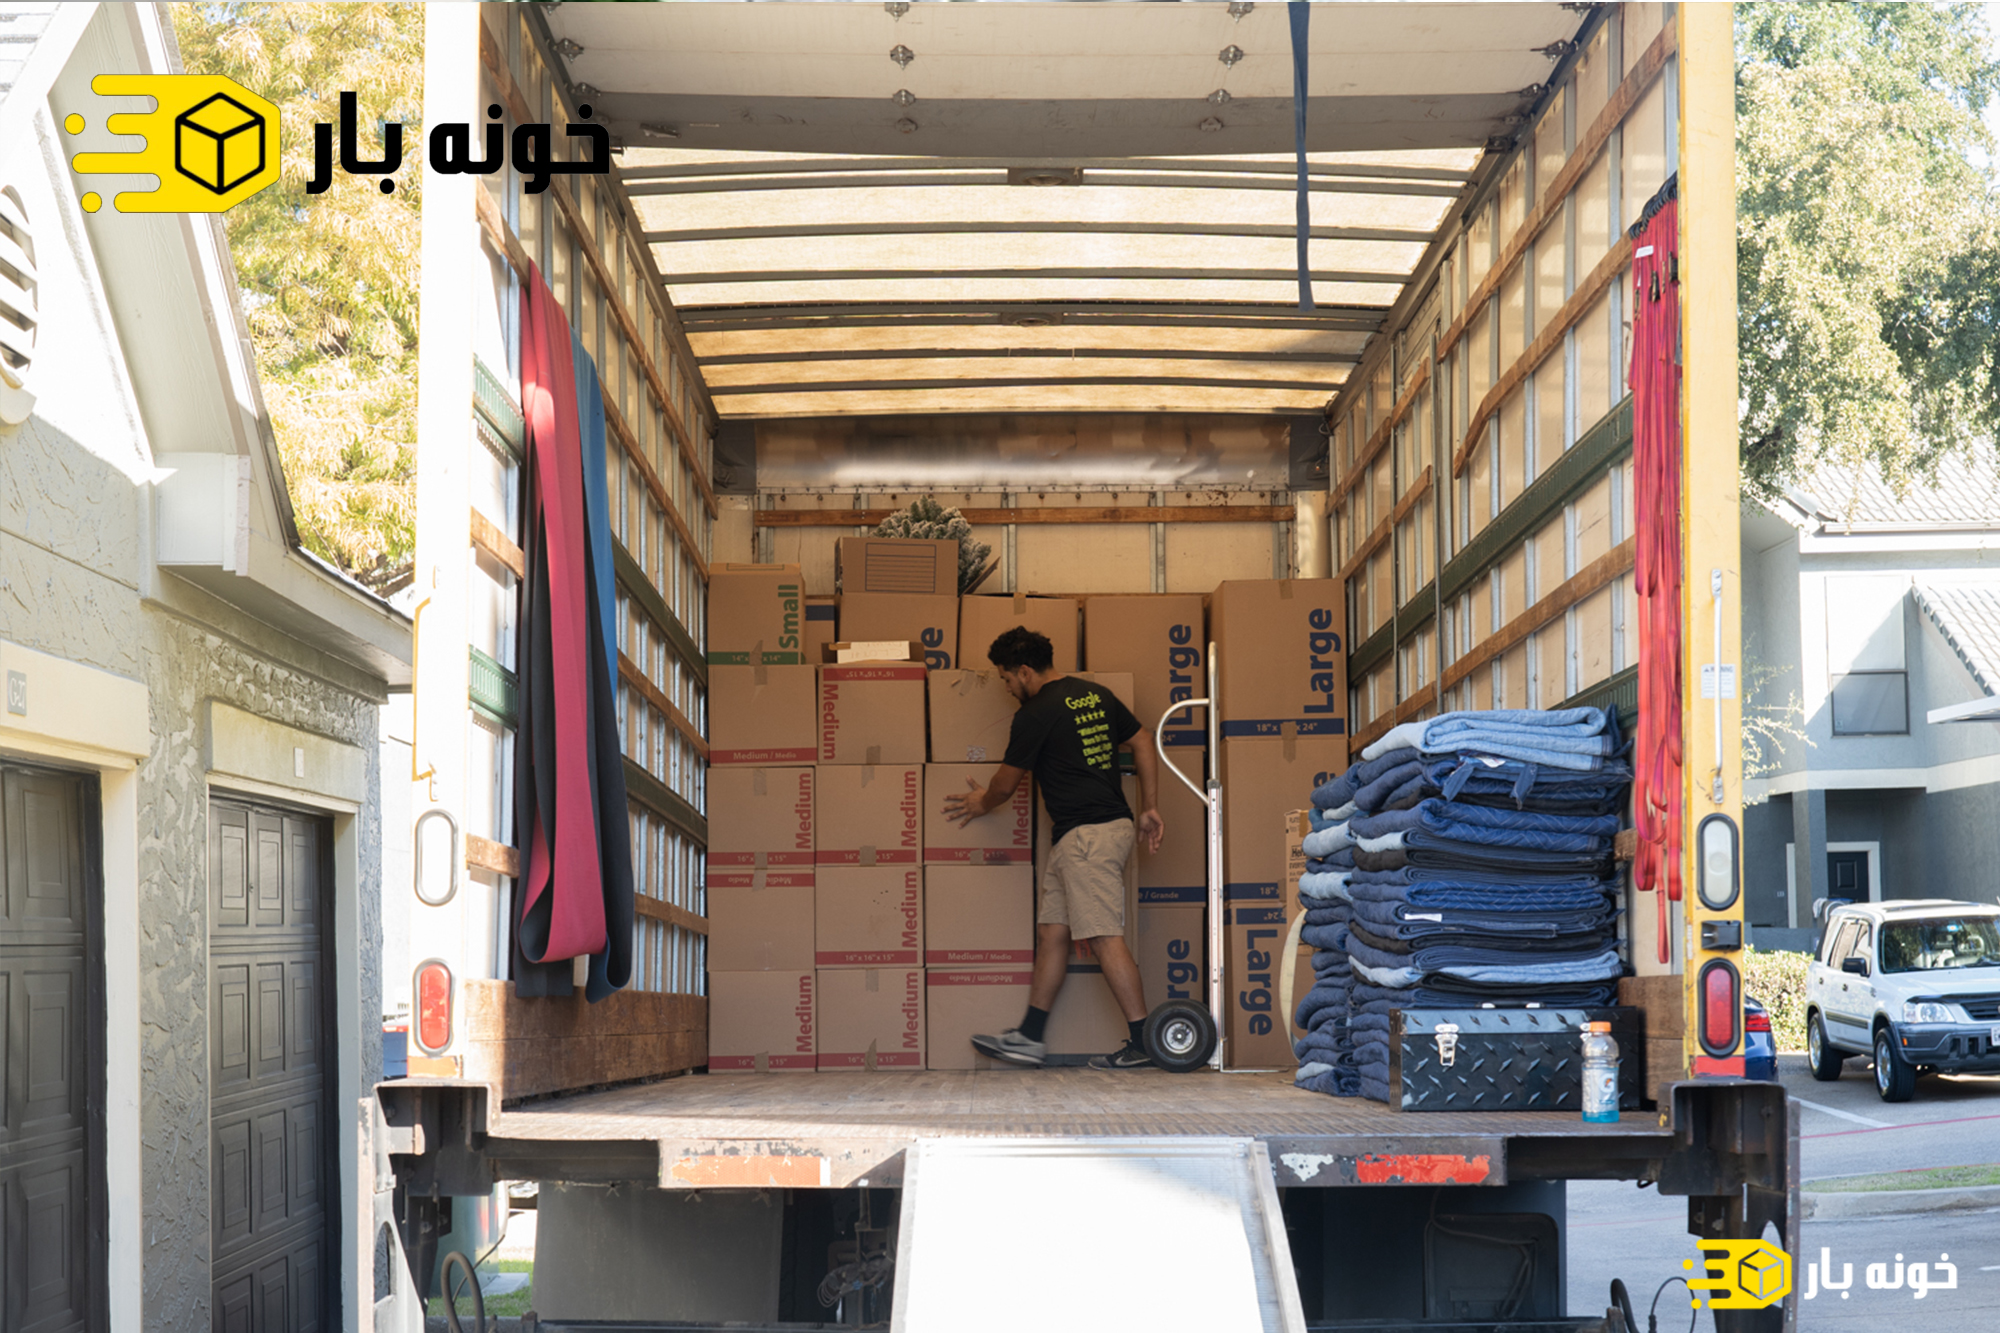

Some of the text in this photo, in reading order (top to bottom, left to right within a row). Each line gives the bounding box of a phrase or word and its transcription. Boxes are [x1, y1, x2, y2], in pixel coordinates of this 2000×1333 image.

[778, 584, 799, 649] Small
[1165, 624, 1200, 725] Large
[1304, 608, 1341, 713] Large
[823, 684, 839, 760] Medium
[1065, 691, 1102, 710] Google
[1256, 723, 1271, 732] 18"
[1302, 722, 1318, 731] 24"
[733, 752, 768, 760] Medium
[795, 774, 811, 849] Medium
[900, 771, 916, 847] Medium
[901, 872, 917, 948] Medium
[1150, 891, 1179, 899] Grande
[948, 952, 983, 960] Medium
[977, 975, 1013, 983] Medium
[1167, 939, 1198, 999] rge
[1240, 930, 1278, 1035] Large
[795, 976, 812, 1052] Medium
[902, 972, 918, 1049] Medium
[1599, 1072, 1615, 1093] G
